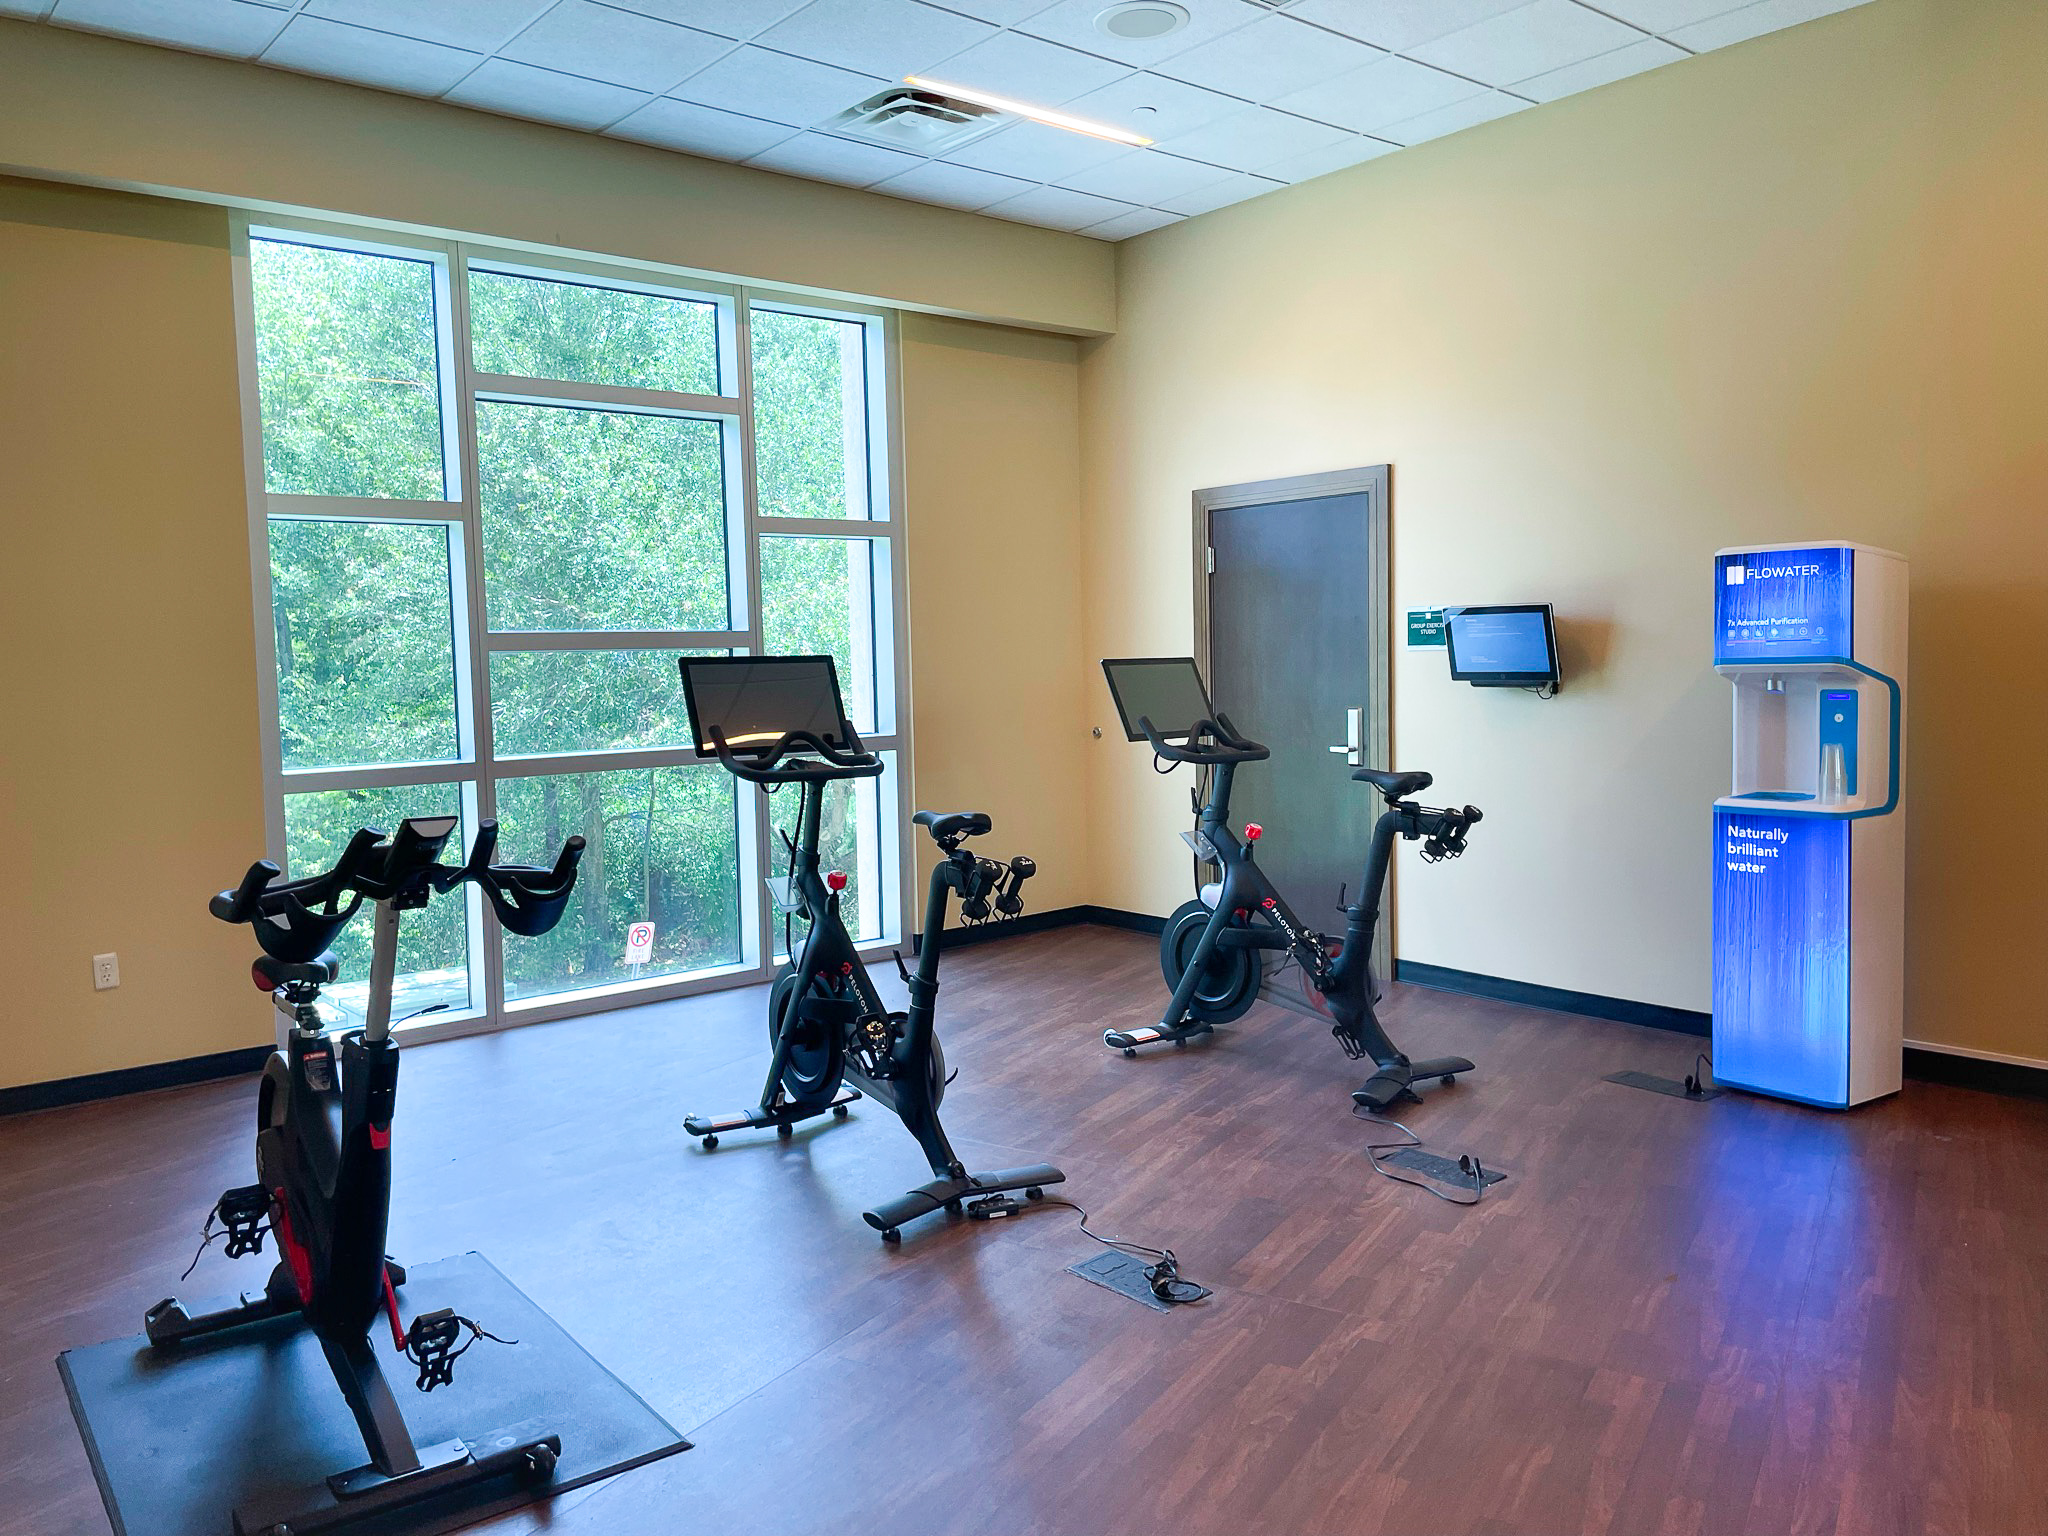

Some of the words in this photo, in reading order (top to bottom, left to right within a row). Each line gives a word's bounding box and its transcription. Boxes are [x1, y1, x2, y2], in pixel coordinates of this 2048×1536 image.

[1746, 565, 1819, 579] FLOWATER
[1727, 619, 1736, 627] 7x
[1737, 618, 1769, 626] Advanced
[1771, 617, 1808, 625] Purification
[1728, 825, 1789, 844] Naturally
[1728, 842, 1778, 857] brilliant
[1727, 862, 1766, 873] water
[1271, 908, 1295, 939] PELOTON
[849, 974, 868, 1013] PELOTON
